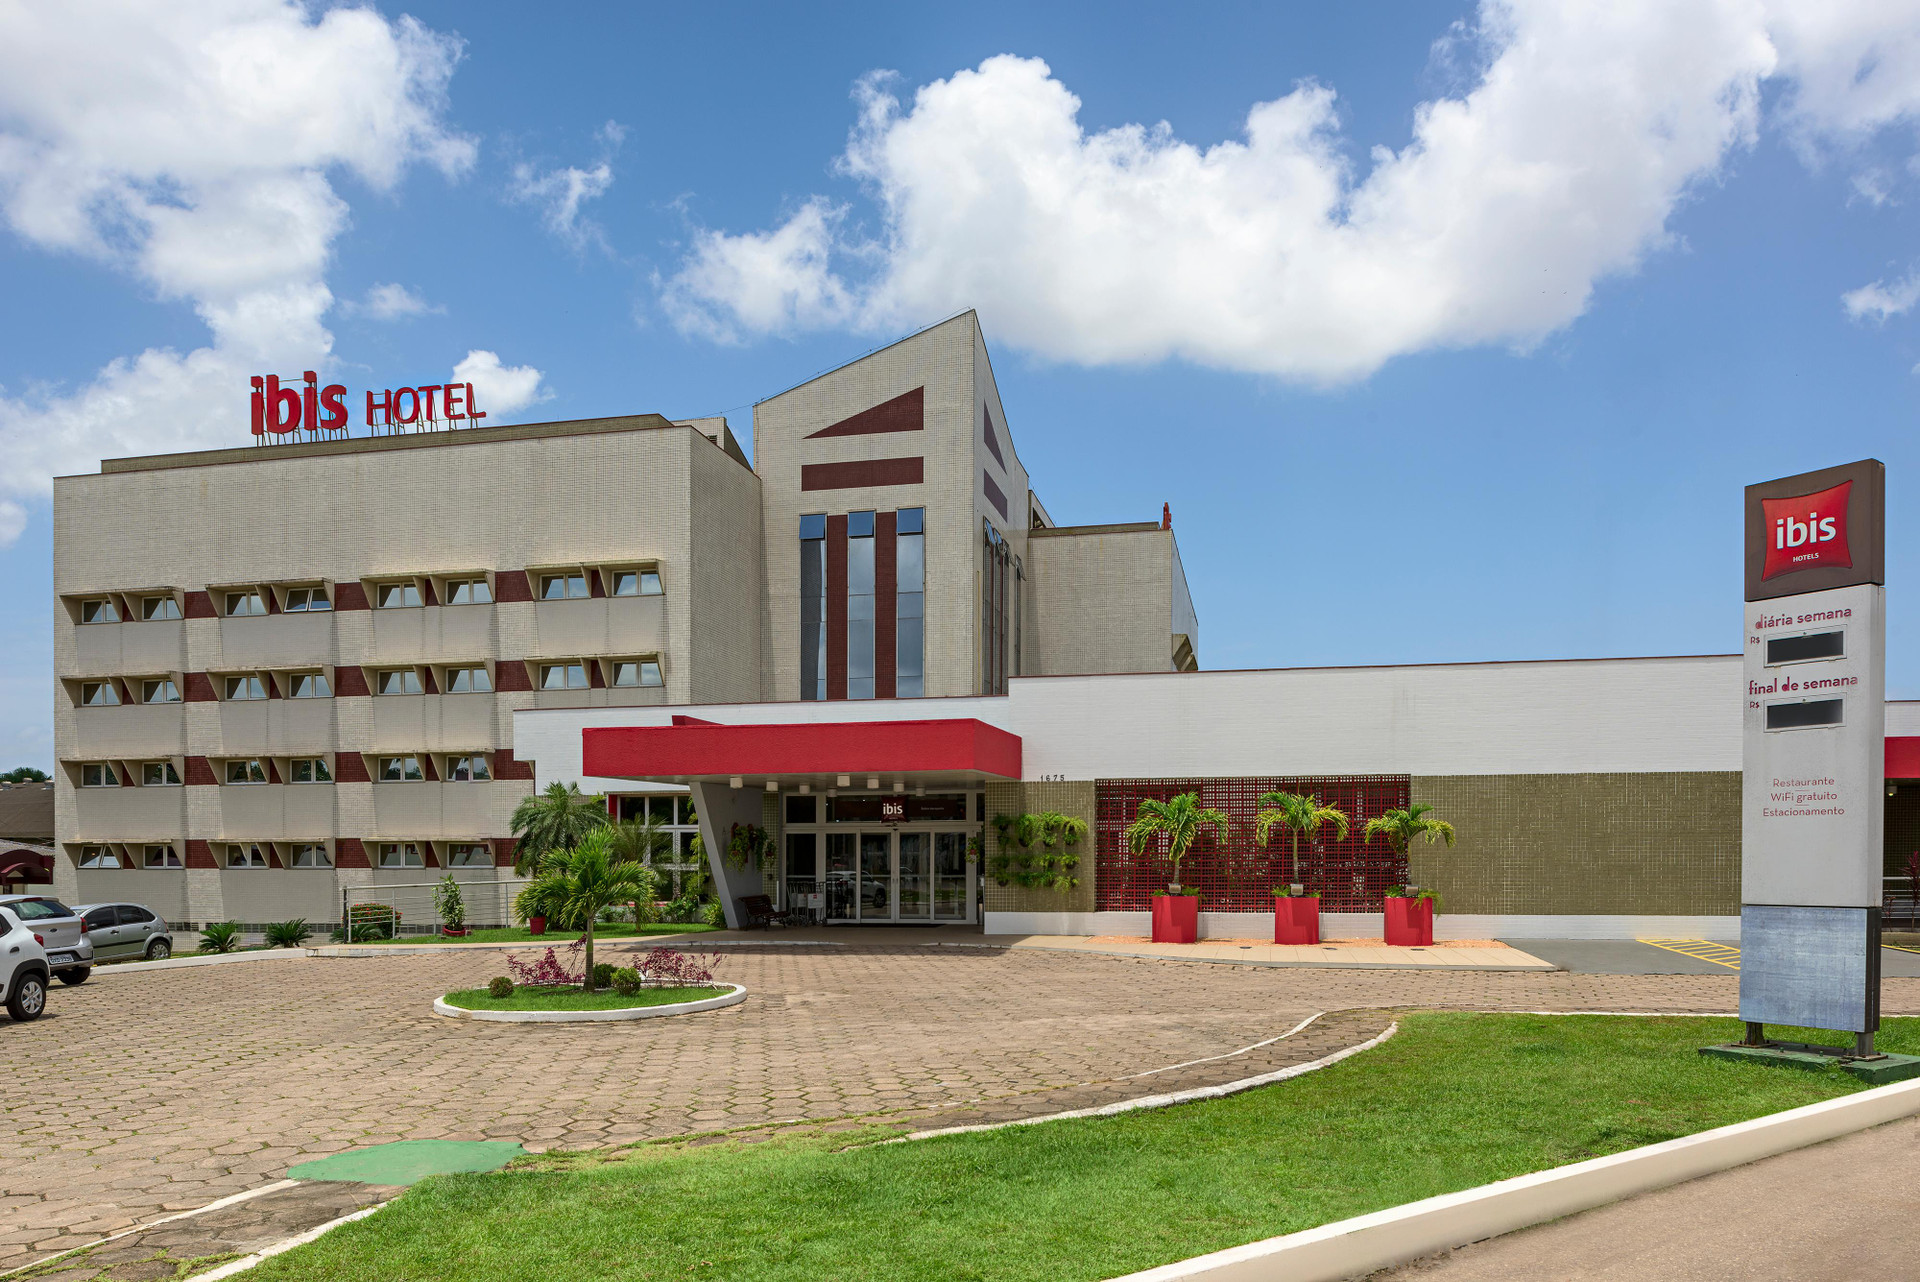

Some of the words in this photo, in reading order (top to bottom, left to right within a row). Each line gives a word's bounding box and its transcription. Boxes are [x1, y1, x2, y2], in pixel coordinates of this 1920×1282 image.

[250, 370, 349, 436] ibis
[366, 382, 487, 426] HOTEL
[1776, 511, 1837, 550] ibis
[1792, 552, 1820, 563] HOTELS
[1755, 613, 1793, 630] diária
[1797, 608, 1852, 624] semana
[1750, 636, 1761, 645] R$
[1748, 677, 1778, 695] final
[1781, 676, 1799, 692] de
[1803, 676, 1859, 690] semana
[1749, 701, 1760, 709] R$
[1040, 774, 1065, 782] 1675
[1772, 776, 1835, 788] Restaurante
[1770, 792, 1794, 802] WiFi
[1796, 791, 1838, 804] gratuito
[882, 802, 904, 815] ibis
[1762, 806, 1845, 817] Estacionamento
